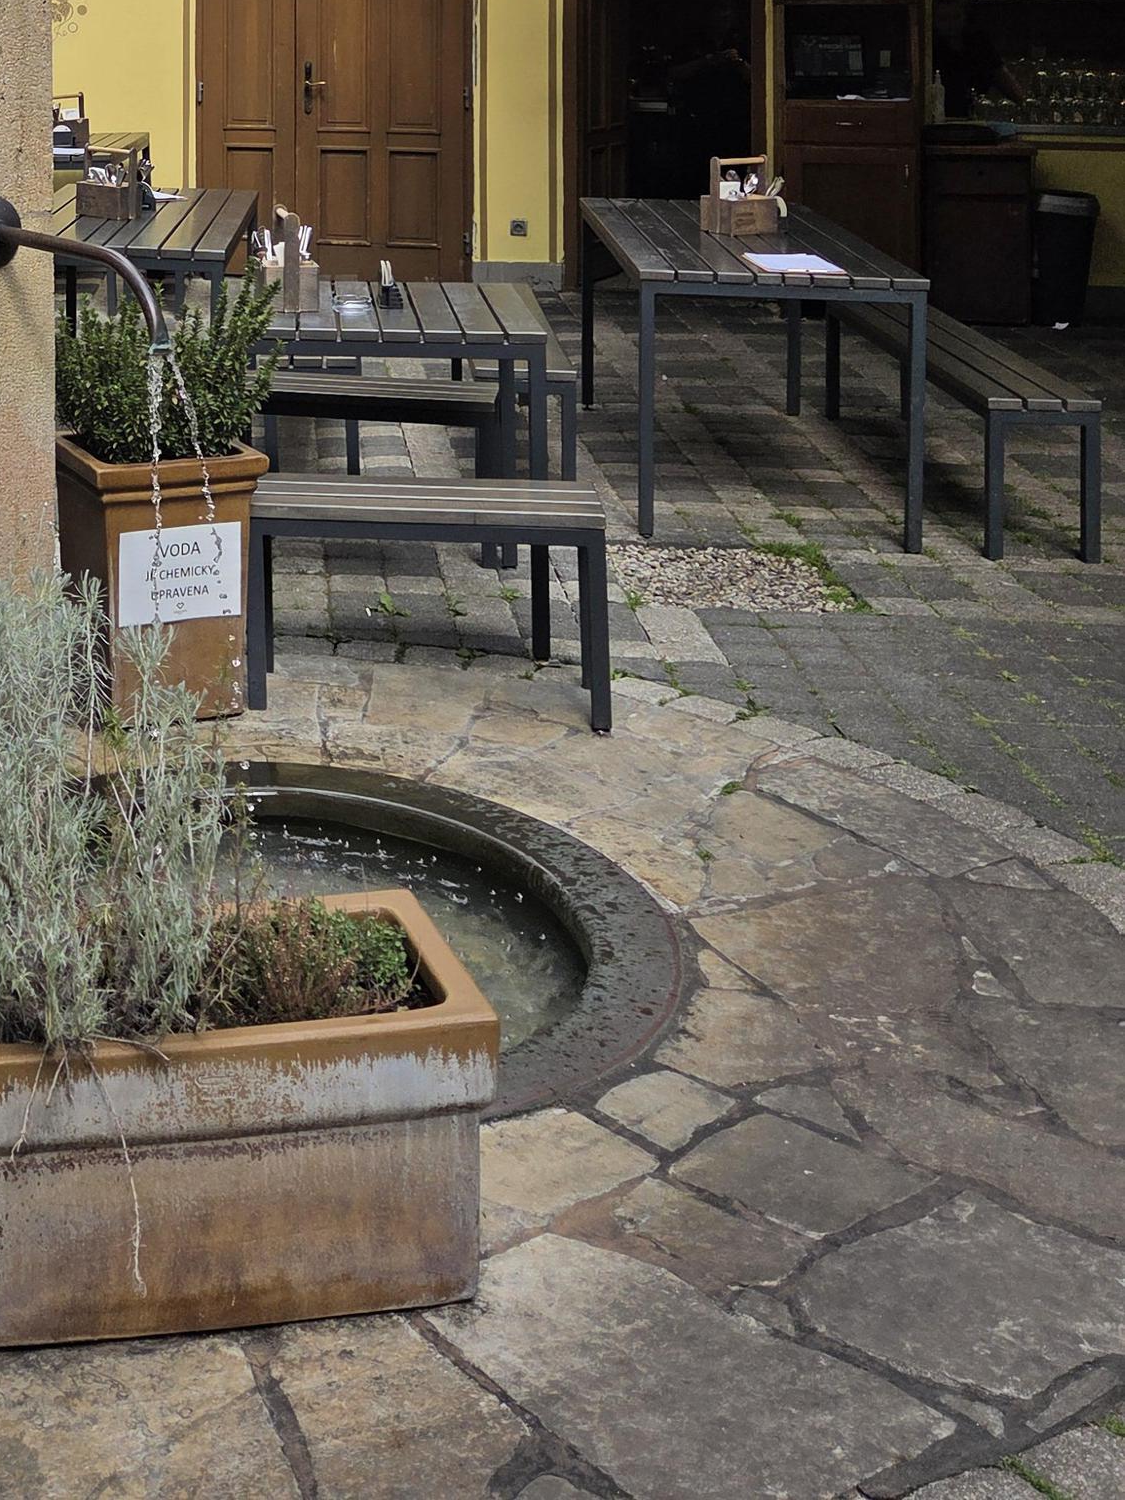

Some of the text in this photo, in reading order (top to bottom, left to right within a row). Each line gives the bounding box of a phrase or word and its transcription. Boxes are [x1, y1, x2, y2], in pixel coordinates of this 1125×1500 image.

[159, 541, 201, 558] VODA
[159, 564, 216, 580] CHEMICKY
[150, 585, 209, 601] UPRAVENA
